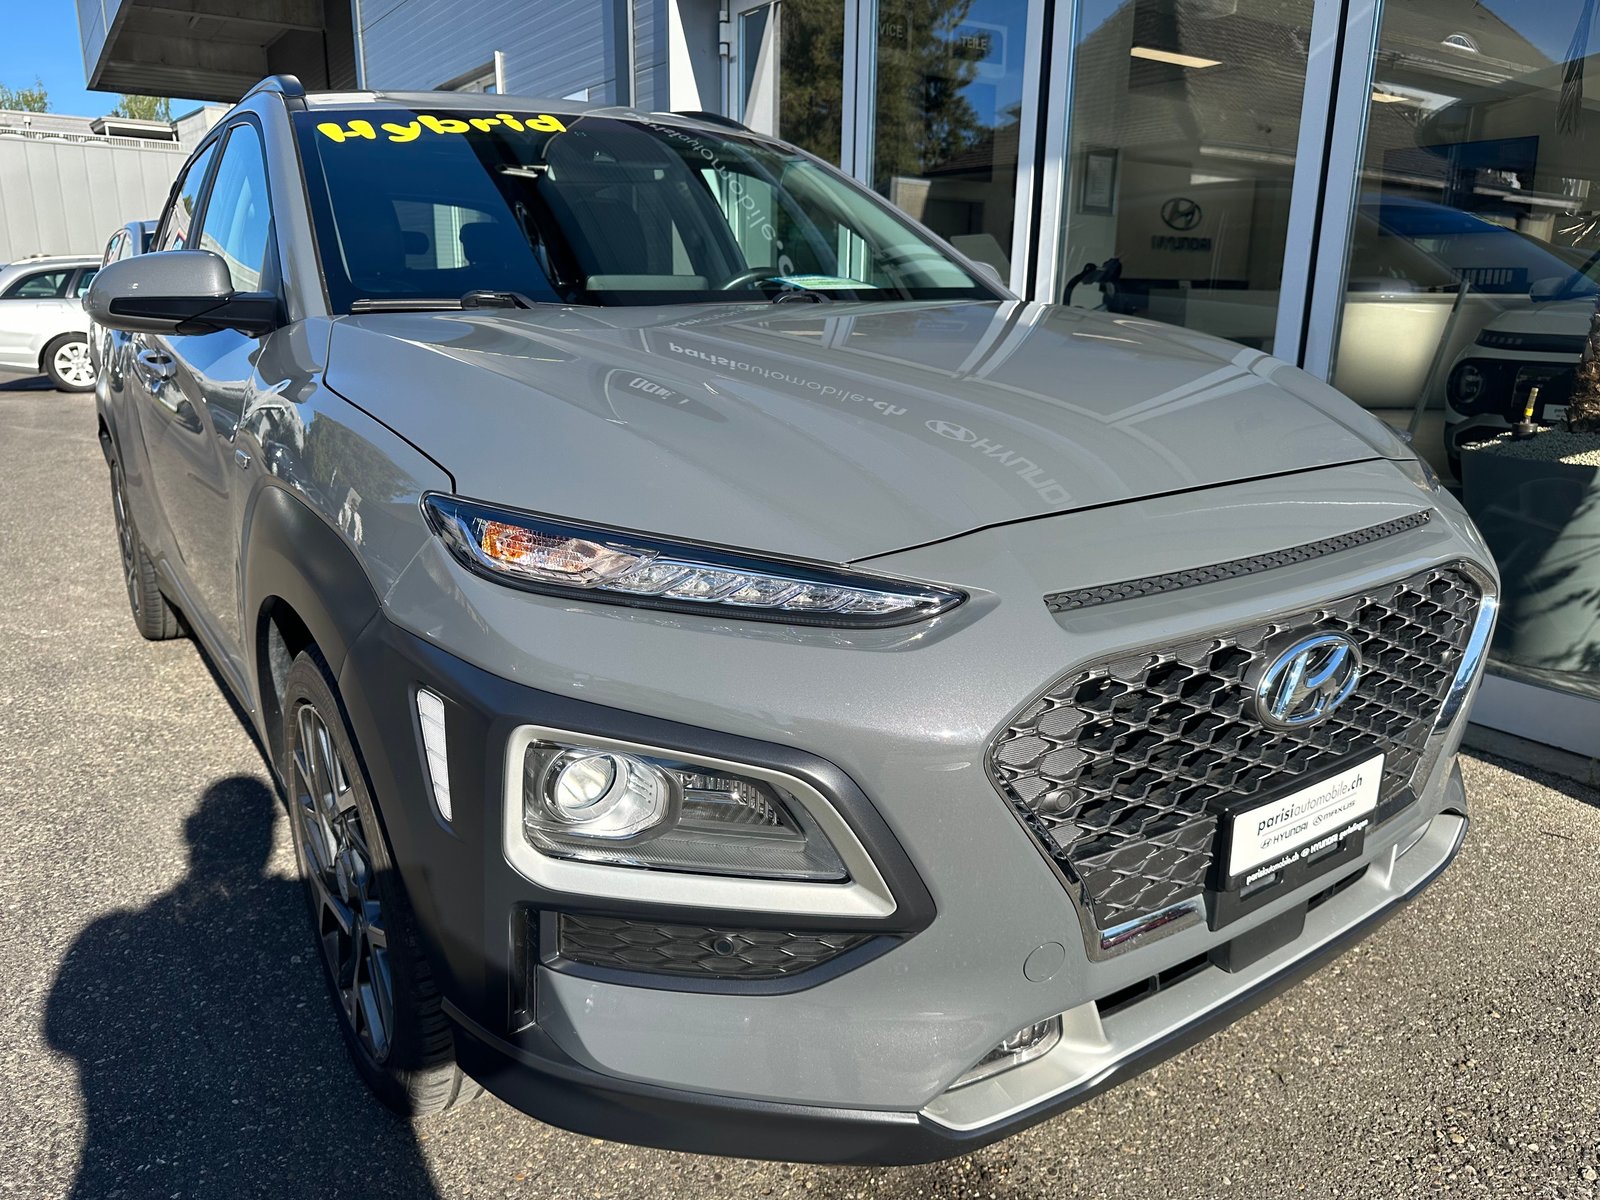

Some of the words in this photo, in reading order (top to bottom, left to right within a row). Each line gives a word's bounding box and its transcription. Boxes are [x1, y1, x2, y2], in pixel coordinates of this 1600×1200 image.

[961, 36, 988, 50] TEILE
[316, 113, 567, 142] Hybrid
[1257, 773, 1363, 835] parisiautomobile.ch
[1273, 822, 1309, 845] HYUNDAI
[1246, 851, 1300, 886] parisiautomobile.ch
[1310, 833, 1339, 854] HYUNDAI
